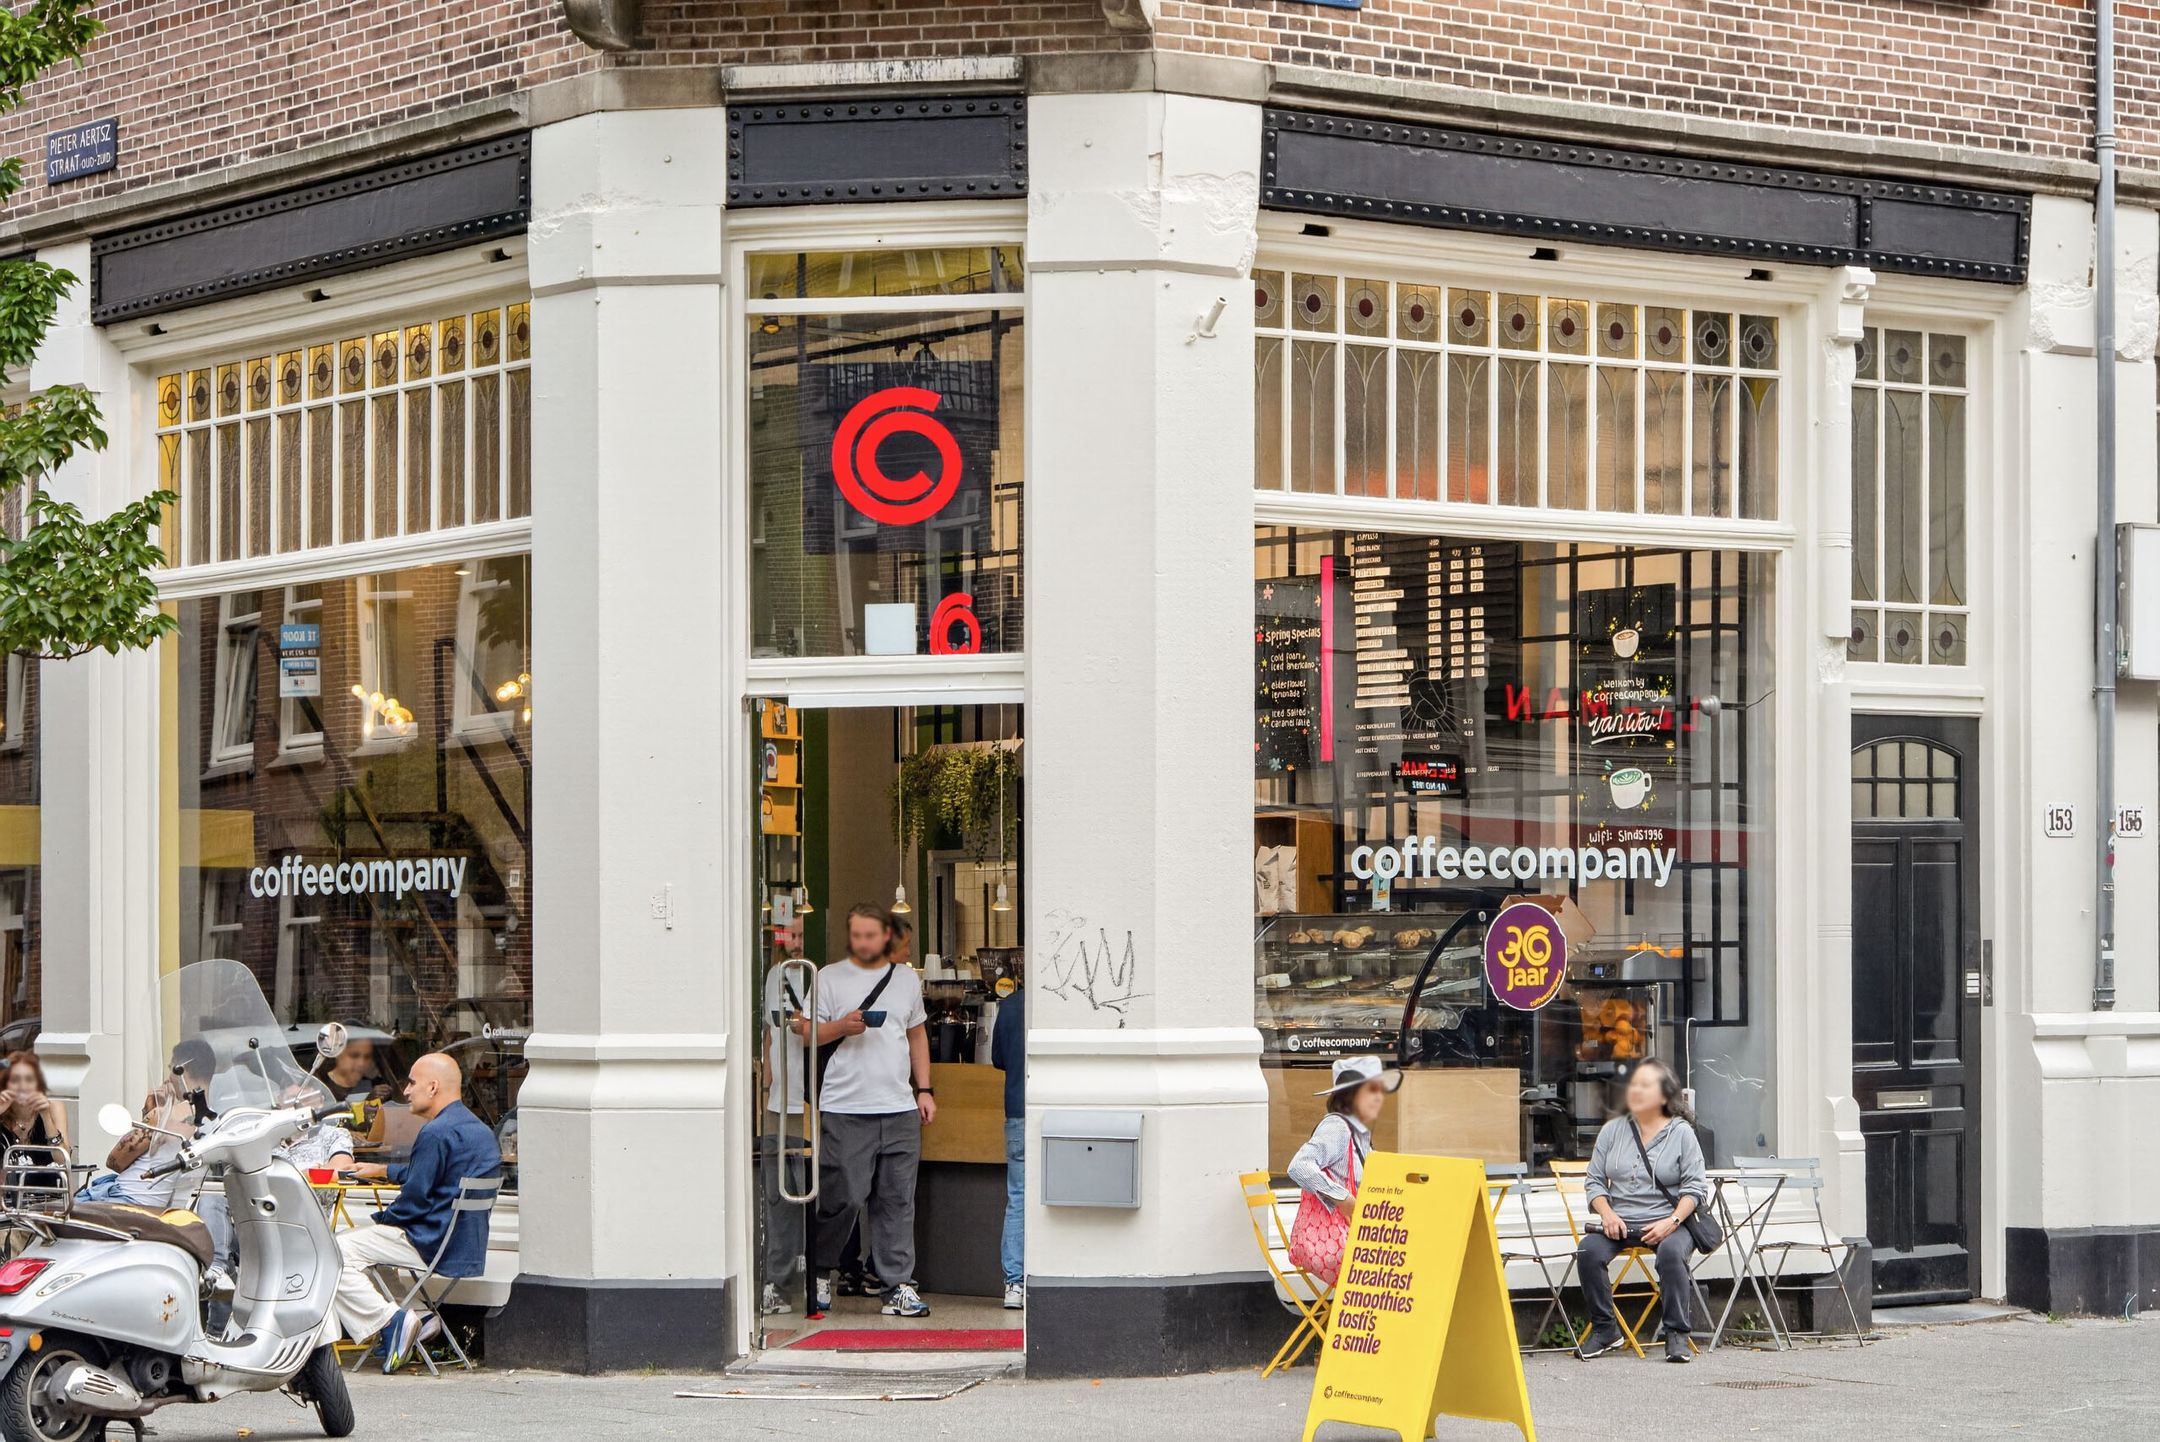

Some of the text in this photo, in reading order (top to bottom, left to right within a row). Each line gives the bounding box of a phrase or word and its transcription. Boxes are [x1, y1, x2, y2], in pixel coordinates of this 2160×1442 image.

[50, 124, 111, 156] PIETER AERTSZ
[50, 154, 80, 178] STRAAT
[2049, 808, 2073, 831] 153
[2119, 810, 2143, 832] 155
[1350, 835, 1677, 888] coffeecompany
[249, 854, 467, 900] coffeecompany
[1507, 967, 1549, 991] jaar
[1302, 1037, 1371, 1048] coffeecompany
[1386, 1186, 1393, 1194] in
[1362, 1200, 1404, 1222] coffee
[1357, 1224, 1408, 1245] matcha
[1352, 1246, 1406, 1267] pastries
[1347, 1264, 1413, 1291] breakfast
[1342, 1290, 1414, 1313] smoothies
[1337, 1309, 1377, 1332] tosti's
[1332, 1333, 1381, 1355] a smile
